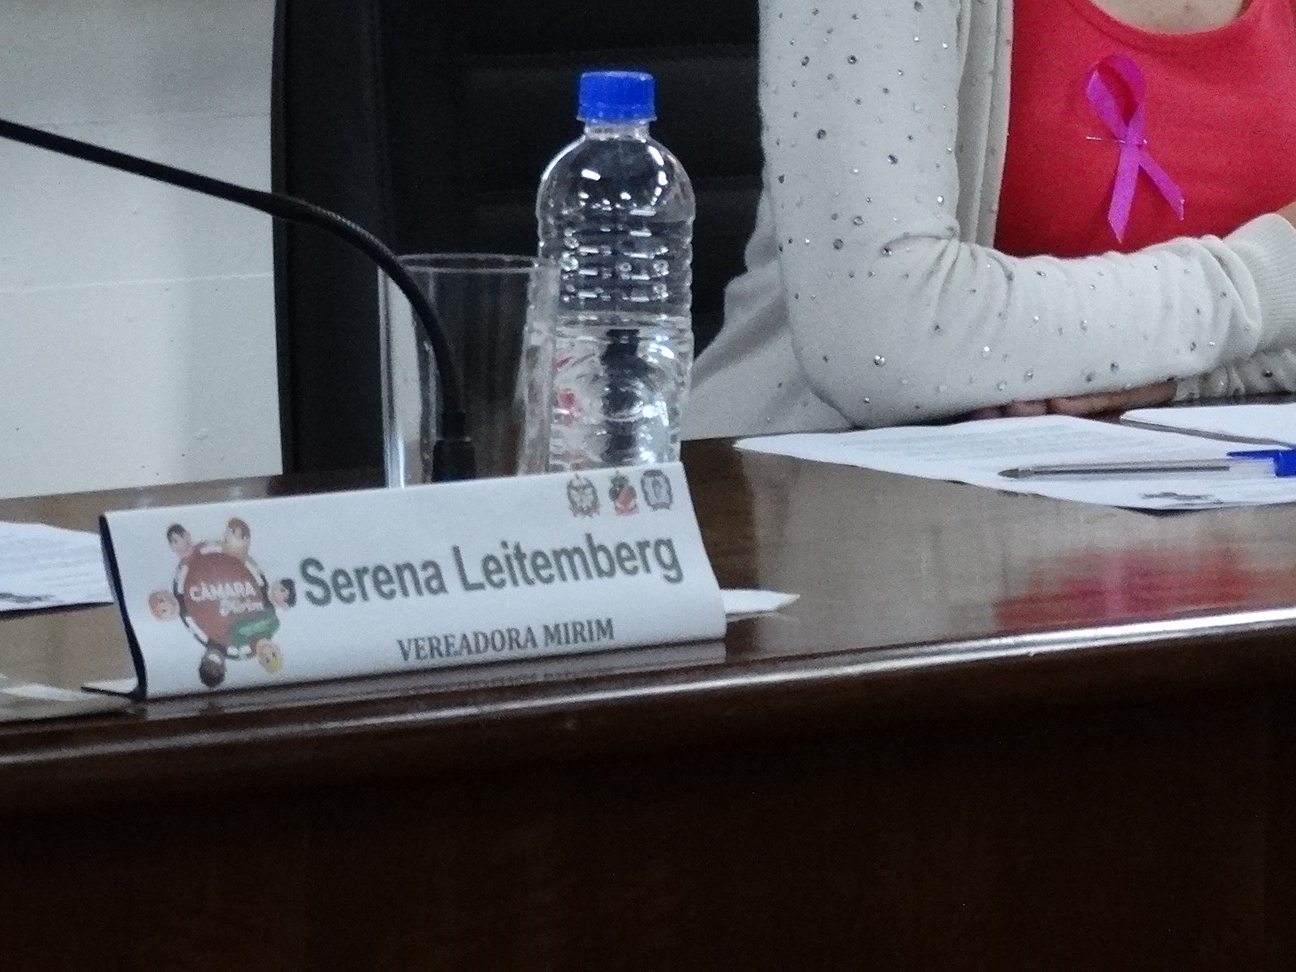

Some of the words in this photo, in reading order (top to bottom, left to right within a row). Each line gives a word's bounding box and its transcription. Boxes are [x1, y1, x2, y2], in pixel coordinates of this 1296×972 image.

[300, 547, 449, 607] Serena
[452, 532, 684, 592] Leitemberg
[396, 625, 538, 662] VEREADORA
[542, 617, 616, 649] MIRIM
